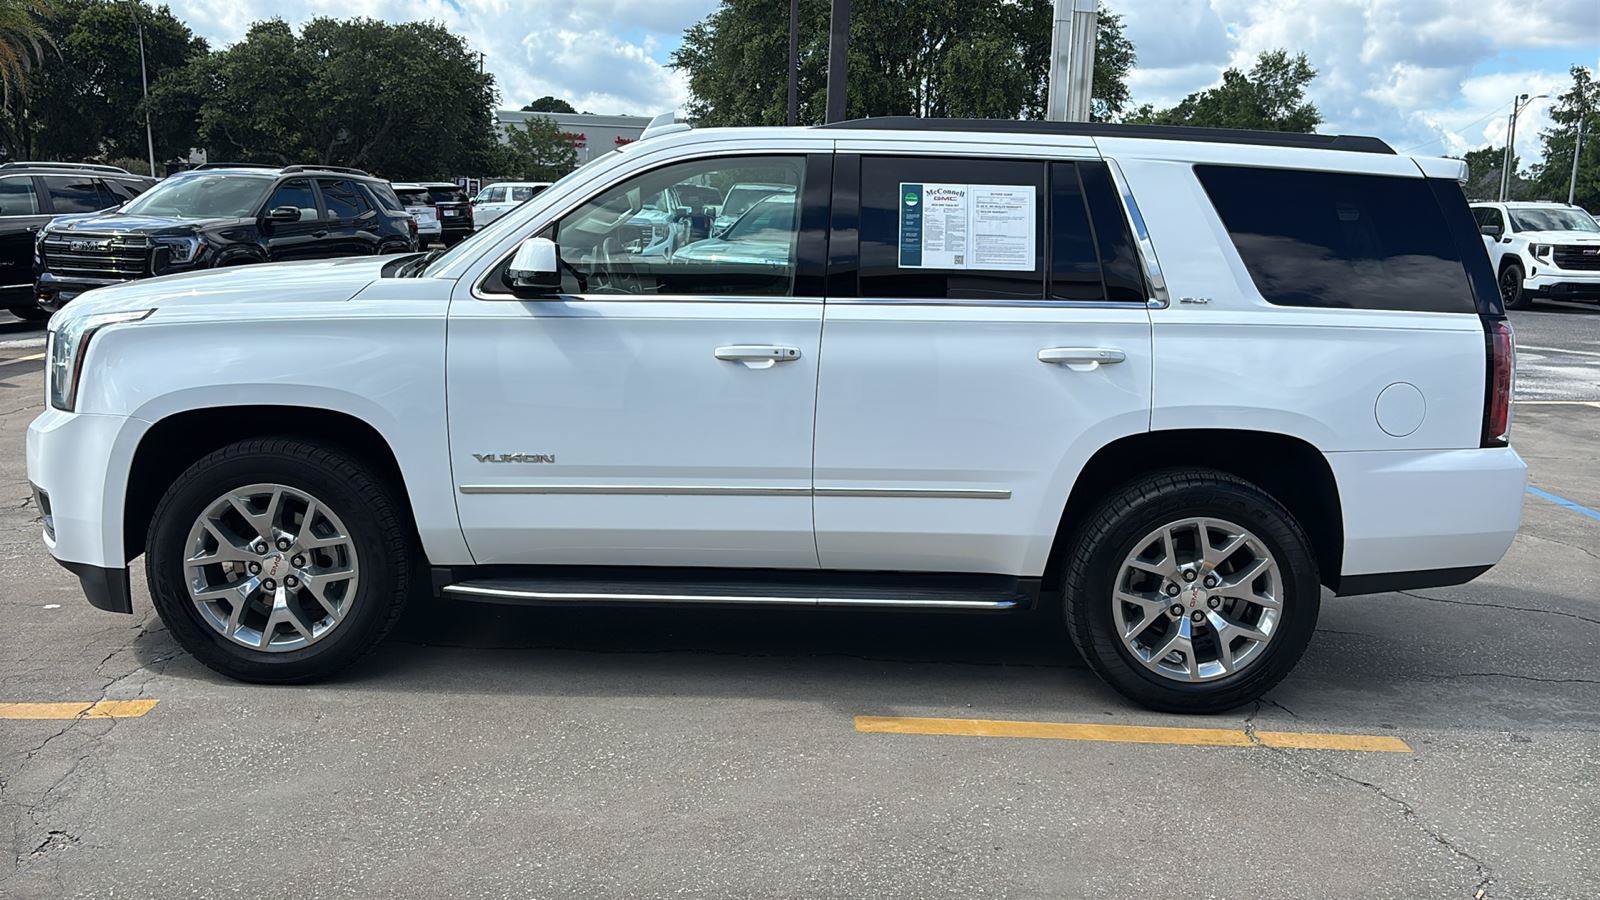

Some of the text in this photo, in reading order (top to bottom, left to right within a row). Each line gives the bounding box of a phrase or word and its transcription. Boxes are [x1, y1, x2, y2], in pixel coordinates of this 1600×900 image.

[926, 188, 965, 198] McConnell
[70, 240, 112, 252] GMC
[1179, 297, 1213, 305] SLT
[472, 454, 555, 464] YUKON
[270, 554, 282, 576] GMC
